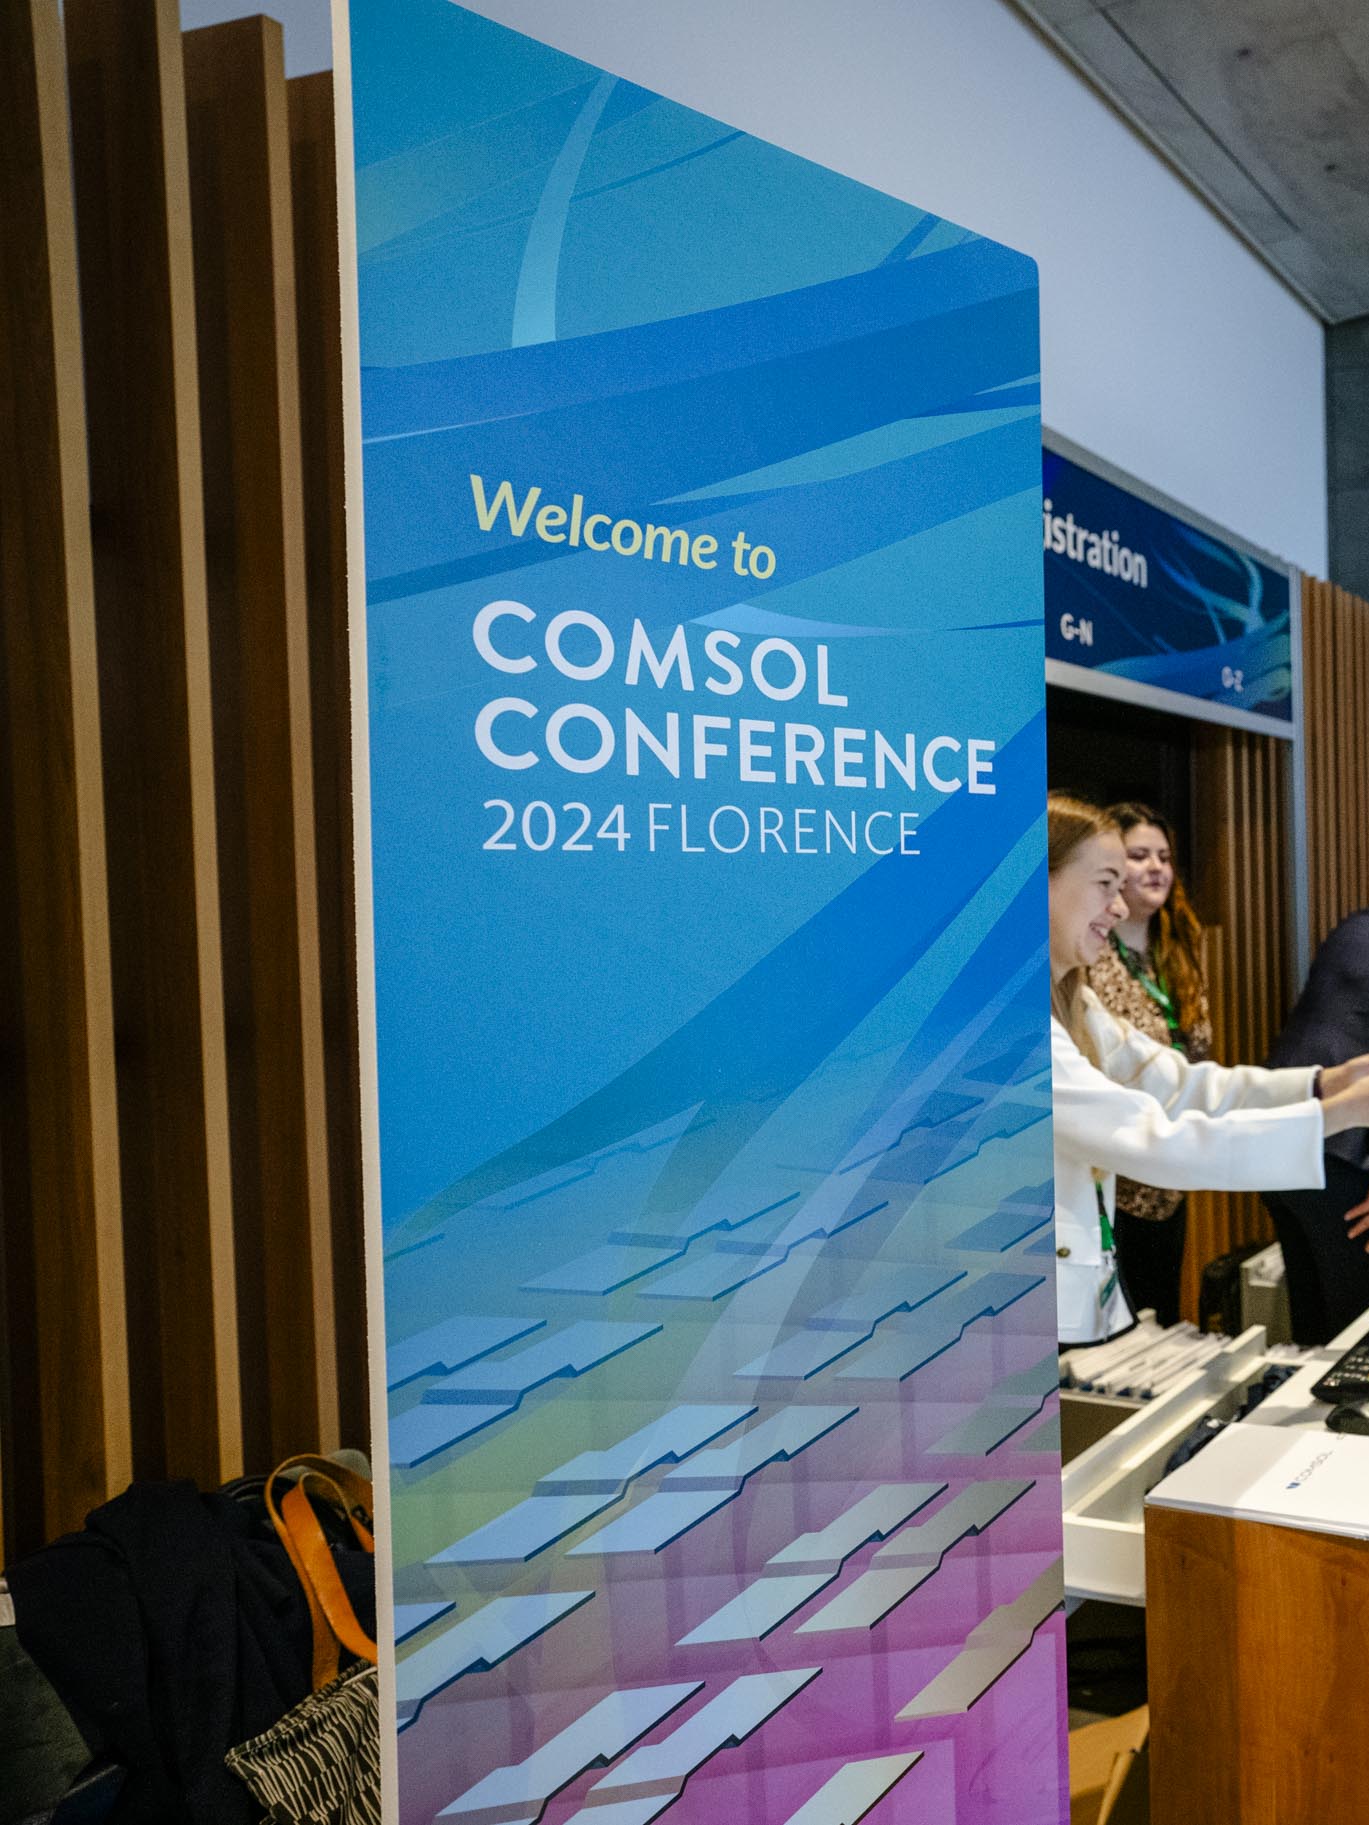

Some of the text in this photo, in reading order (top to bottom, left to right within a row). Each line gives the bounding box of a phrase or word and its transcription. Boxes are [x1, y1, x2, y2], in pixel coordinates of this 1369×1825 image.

[469, 474, 776, 580] Welcome to
[472, 600, 849, 707] COMSOL
[1060, 613, 1093, 646] G-N
[474, 697, 997, 795] CONFERENCE
[482, 799, 921, 856] 2024 FLORENCE
